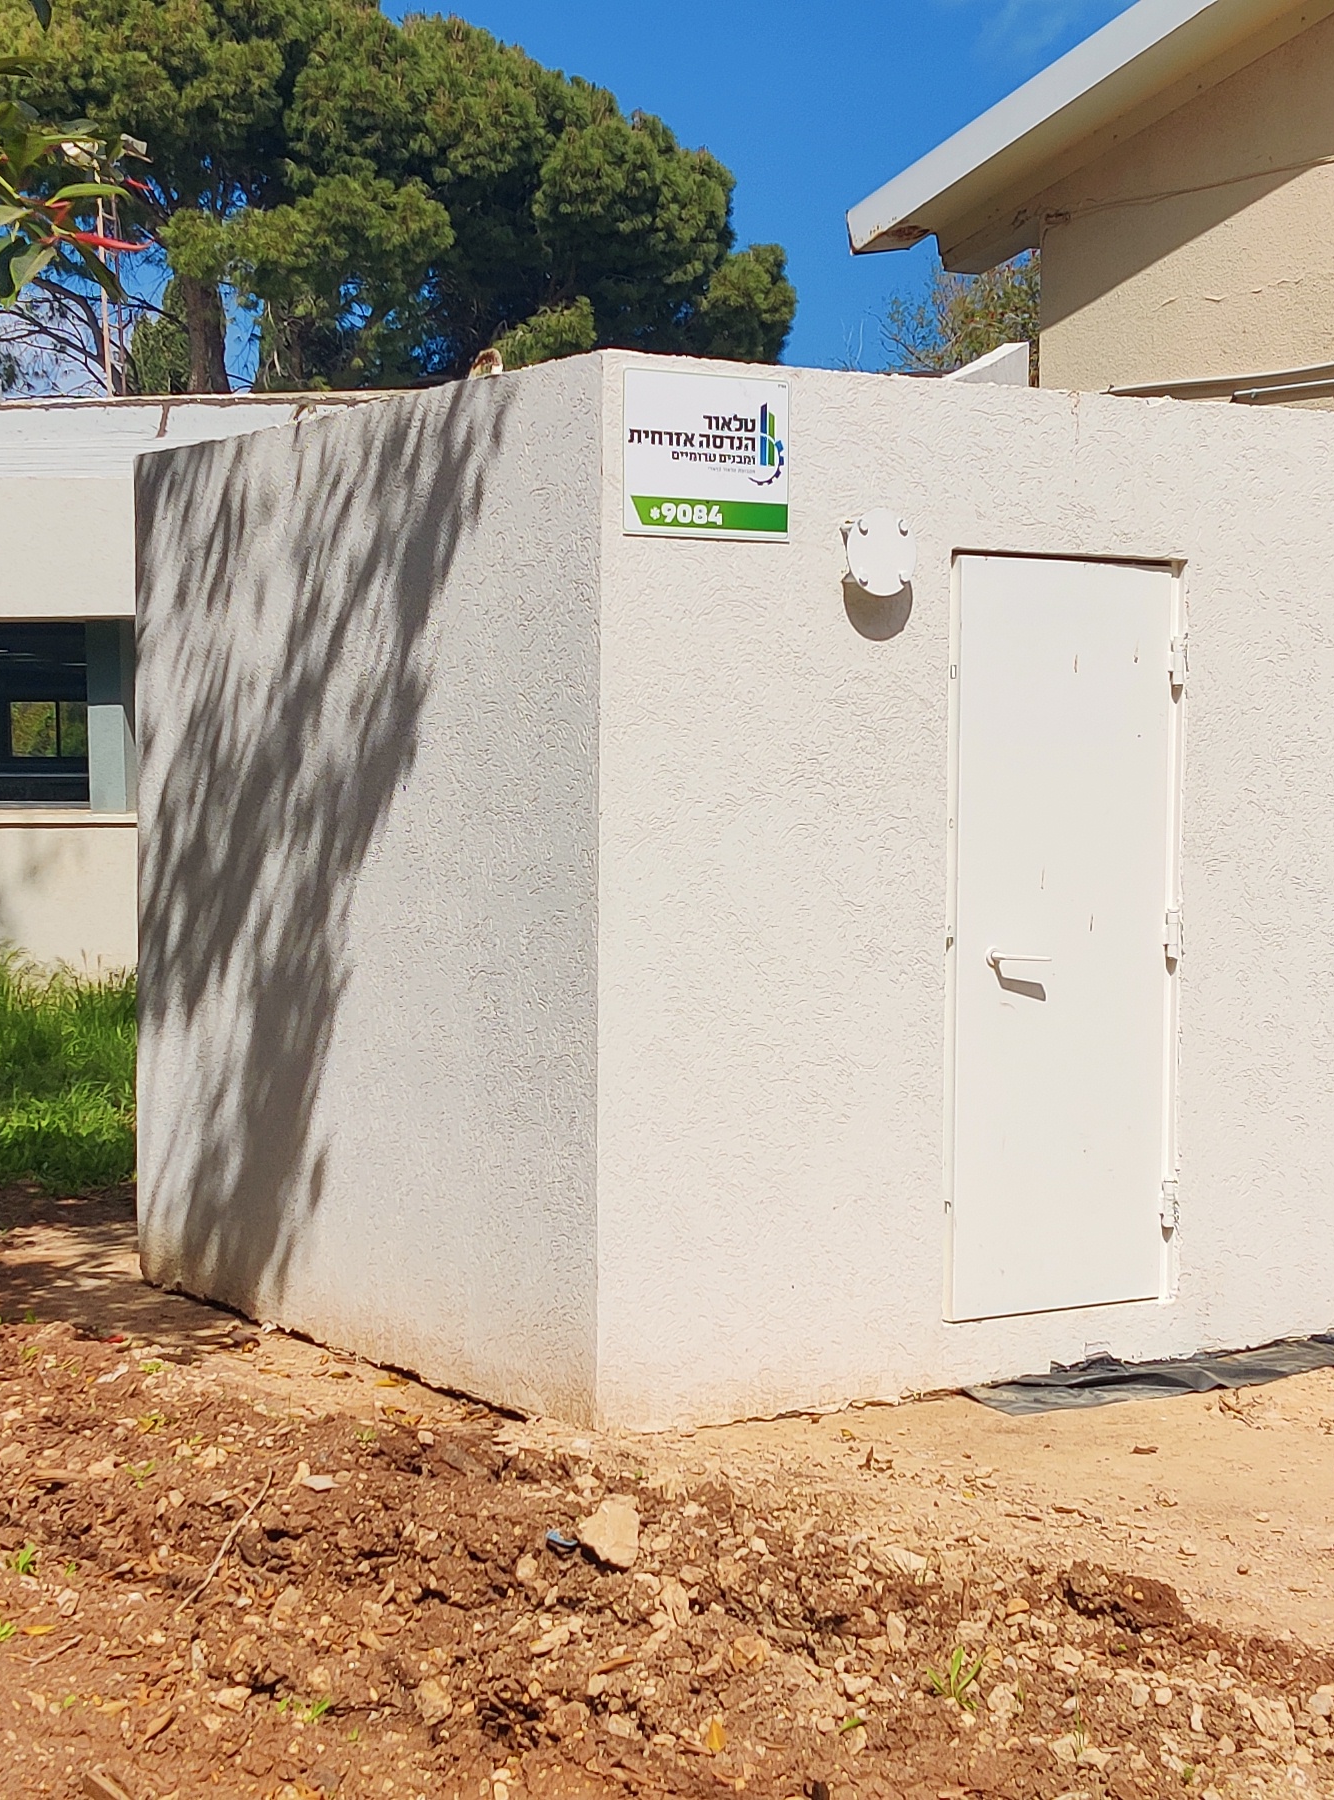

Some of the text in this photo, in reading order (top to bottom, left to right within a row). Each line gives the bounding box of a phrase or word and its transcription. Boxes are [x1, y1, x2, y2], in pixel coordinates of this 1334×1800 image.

[703, 414, 756, 432] טלאור
[628, 428, 756, 452] הנדסה אזרחית
[671, 450, 756, 465] ומבנים טרומיים
